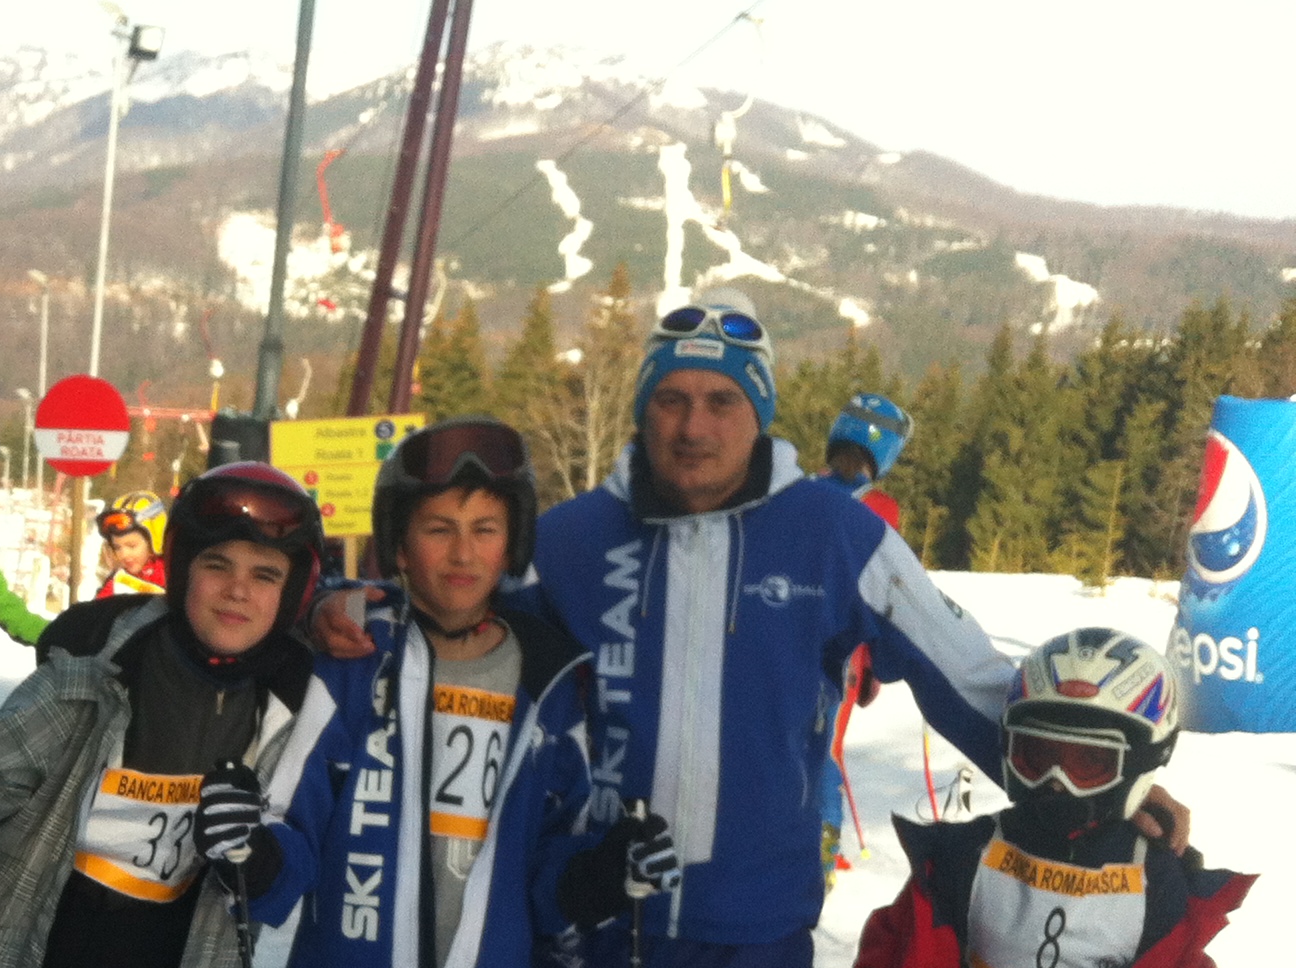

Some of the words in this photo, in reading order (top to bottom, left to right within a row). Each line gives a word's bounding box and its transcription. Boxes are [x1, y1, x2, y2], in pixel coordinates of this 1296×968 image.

[596, 539, 643, 713] TEAM
[117, 775, 165, 803] BANCA
[435, 724, 502, 809] 26
[588, 727, 632, 824] SKI
[132, 811, 194, 881] 33
[340, 852, 385, 942] SKI
